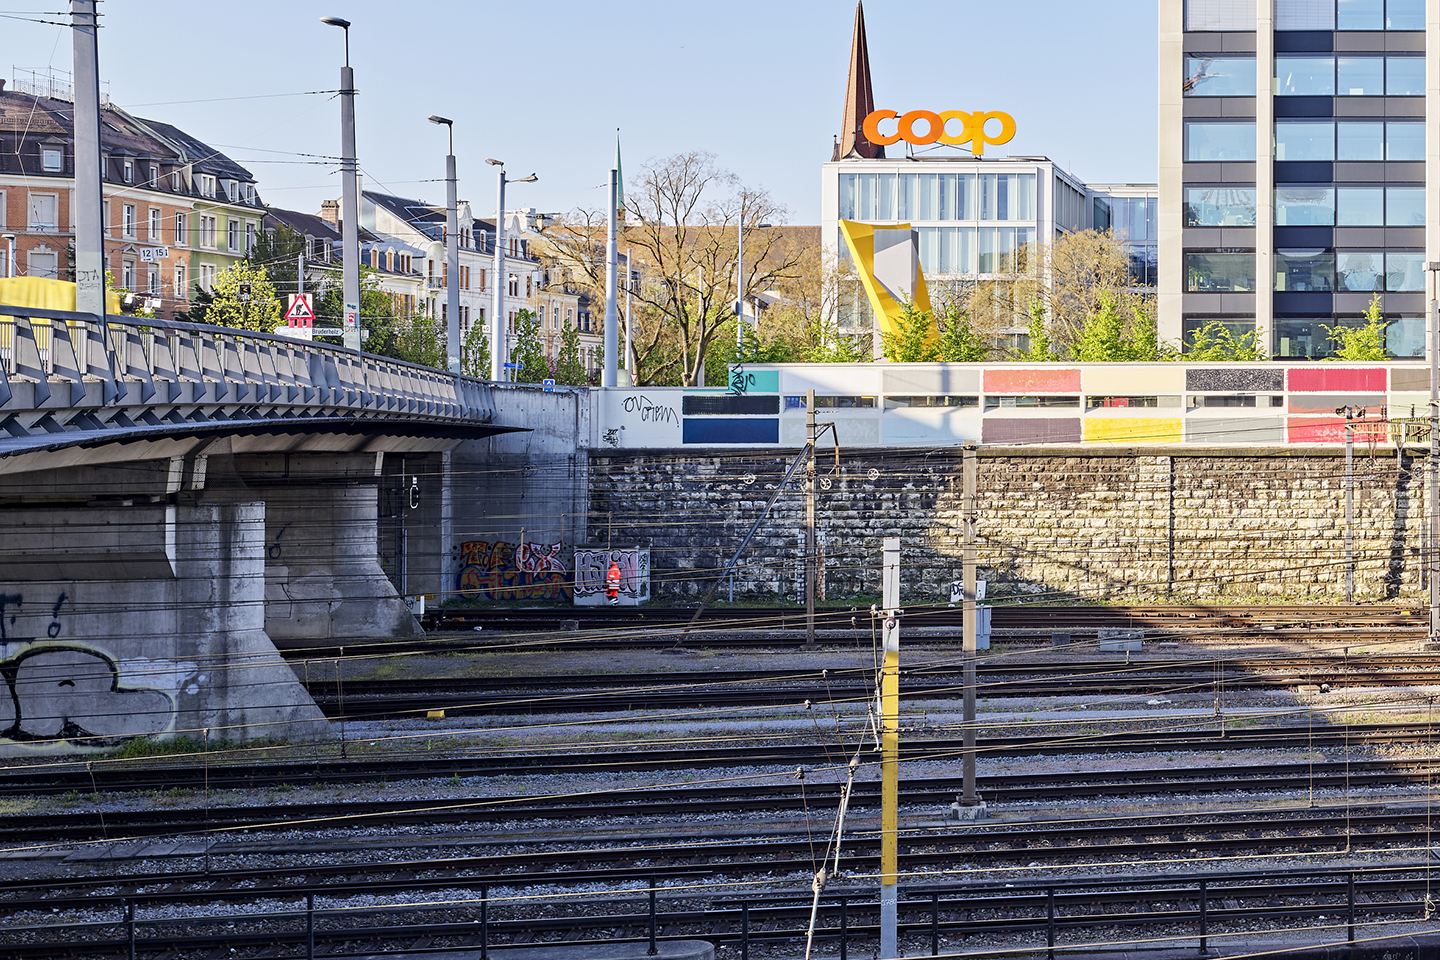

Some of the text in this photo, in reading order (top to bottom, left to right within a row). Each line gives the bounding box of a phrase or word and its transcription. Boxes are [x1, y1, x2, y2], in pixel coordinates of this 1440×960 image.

[862, 109, 1017, 156] coop
[142, 249, 151, 257] 12
[155, 248, 164, 256] 15
